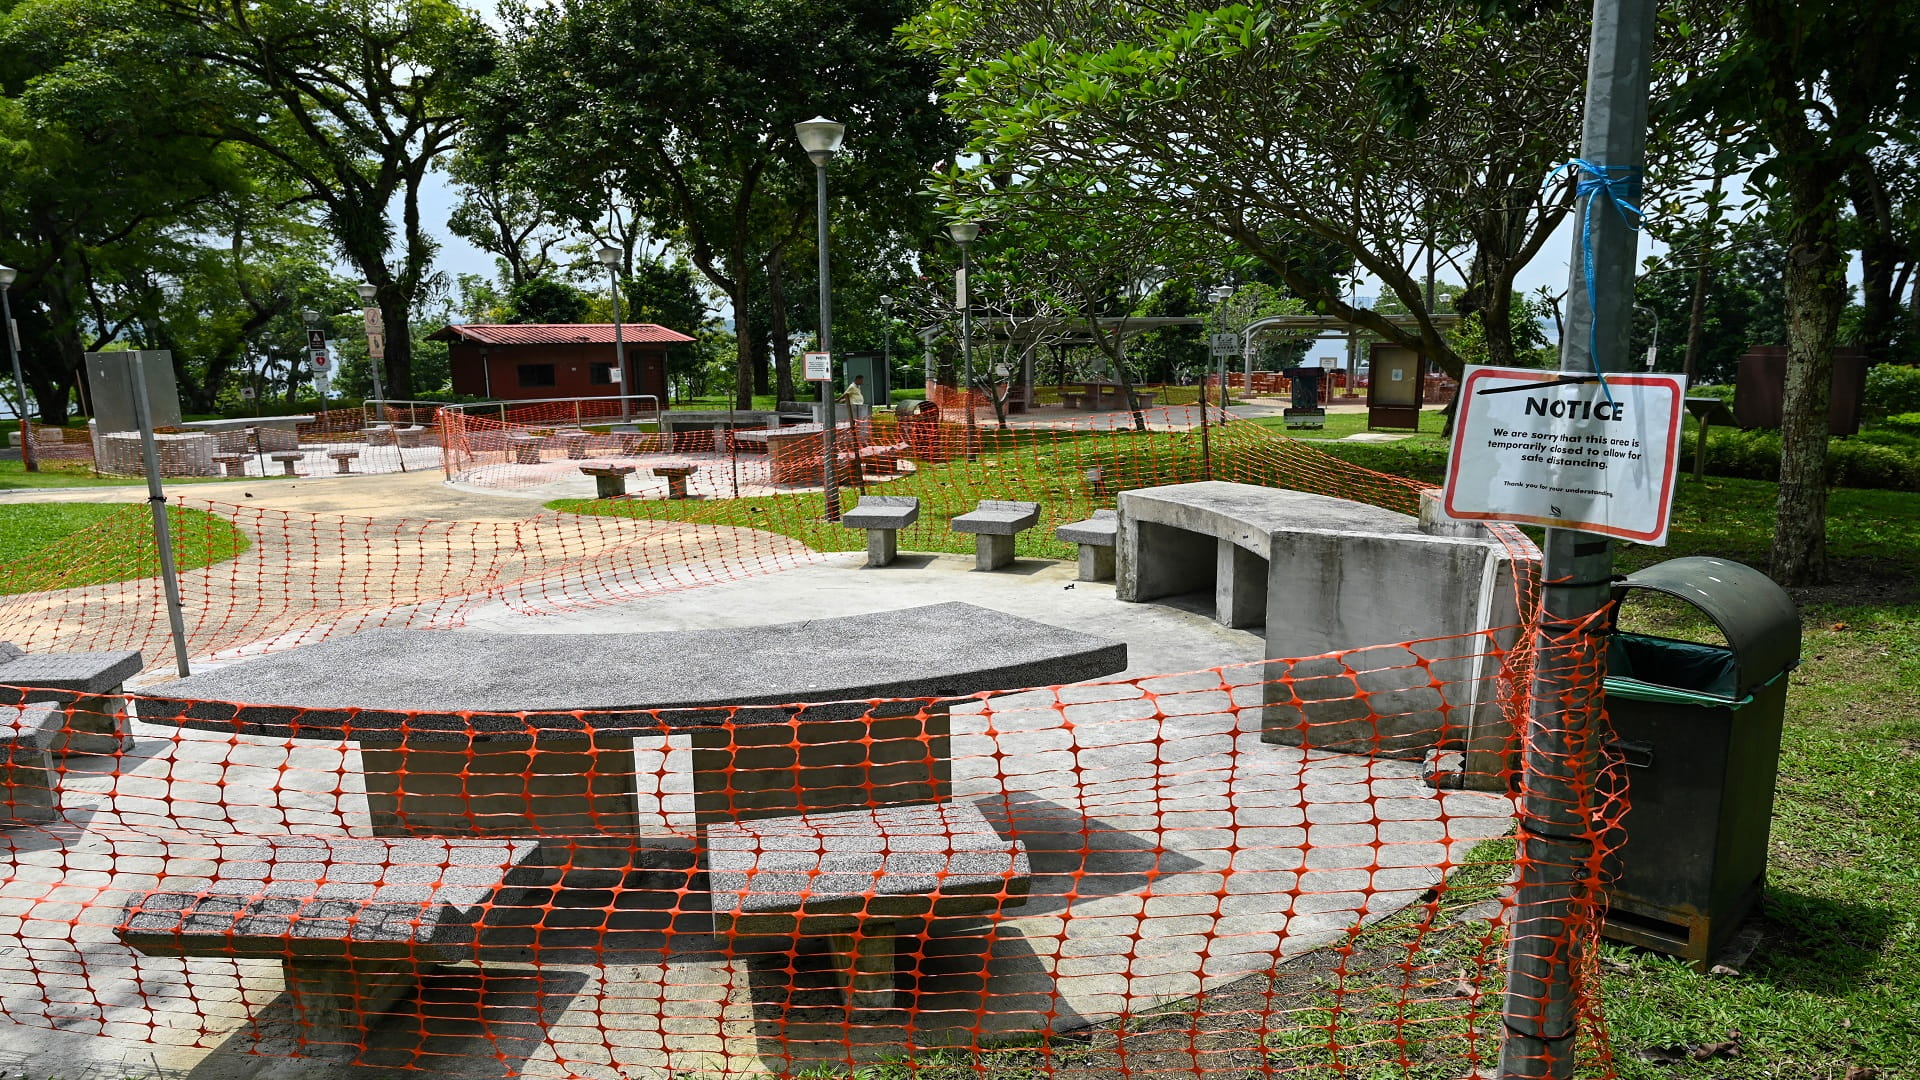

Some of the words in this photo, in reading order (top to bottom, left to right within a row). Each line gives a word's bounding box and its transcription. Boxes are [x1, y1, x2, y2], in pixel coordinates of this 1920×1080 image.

[1525, 397, 1624, 422] NOTICE
[1493, 428, 1508, 436] We
[1531, 432, 1558, 443] sorry
[1560, 433, 1582, 443] that
[1586, 435, 1608, 445] this
[1610, 438, 1630, 446] area
[1632, 438, 1640, 448] is
[1488, 440, 1547, 453] temporarily
[1550, 445, 1584, 455] closed
[1587, 448, 1599, 456] to
[1603, 448, 1626, 458] allow
[1628, 450, 1642, 460] for
[1521, 453, 1543, 463] safe
[1546, 455, 1608, 470] distancing.
